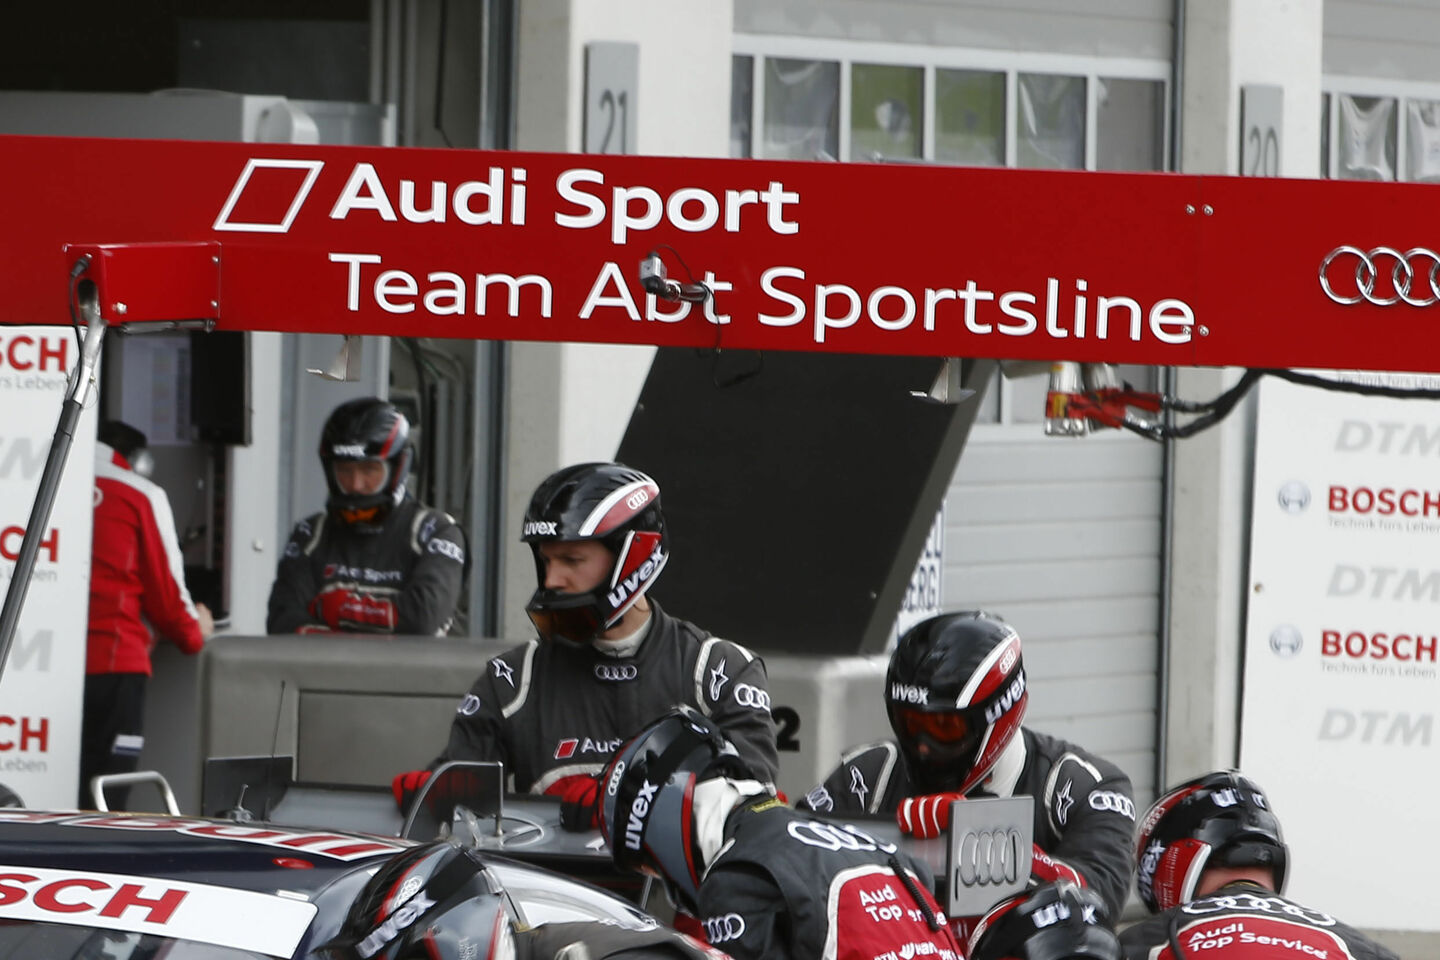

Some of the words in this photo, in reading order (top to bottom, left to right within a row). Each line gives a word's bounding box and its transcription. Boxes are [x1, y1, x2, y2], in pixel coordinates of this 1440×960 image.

[599, 88, 627, 155] 21
[329, 162, 526, 225] Audi
[554, 168, 799, 244] Sport
[328, 252, 553, 317] Team
[578, 261, 733, 326] Abt
[758, 265, 1196, 344] Sportsline
[1328, 485, 1440, 520] BOSCH
[524, 521, 558, 536] uvex
[608, 544, 665, 609] uvex
[1326, 564, 1440, 603] DTM
[1320, 629, 1438, 663] BOSCH
[891, 682, 929, 705] uvex
[985, 668, 1025, 724] uvex
[1317, 706, 1435, 747] DTM
[625, 779, 660, 850] uvex
[865, 905, 903, 922] Top
[1189, 923, 1244, 943] Audi
[1190, 933, 1234, 952] Top
[1239, 932, 1328, 960] Service
